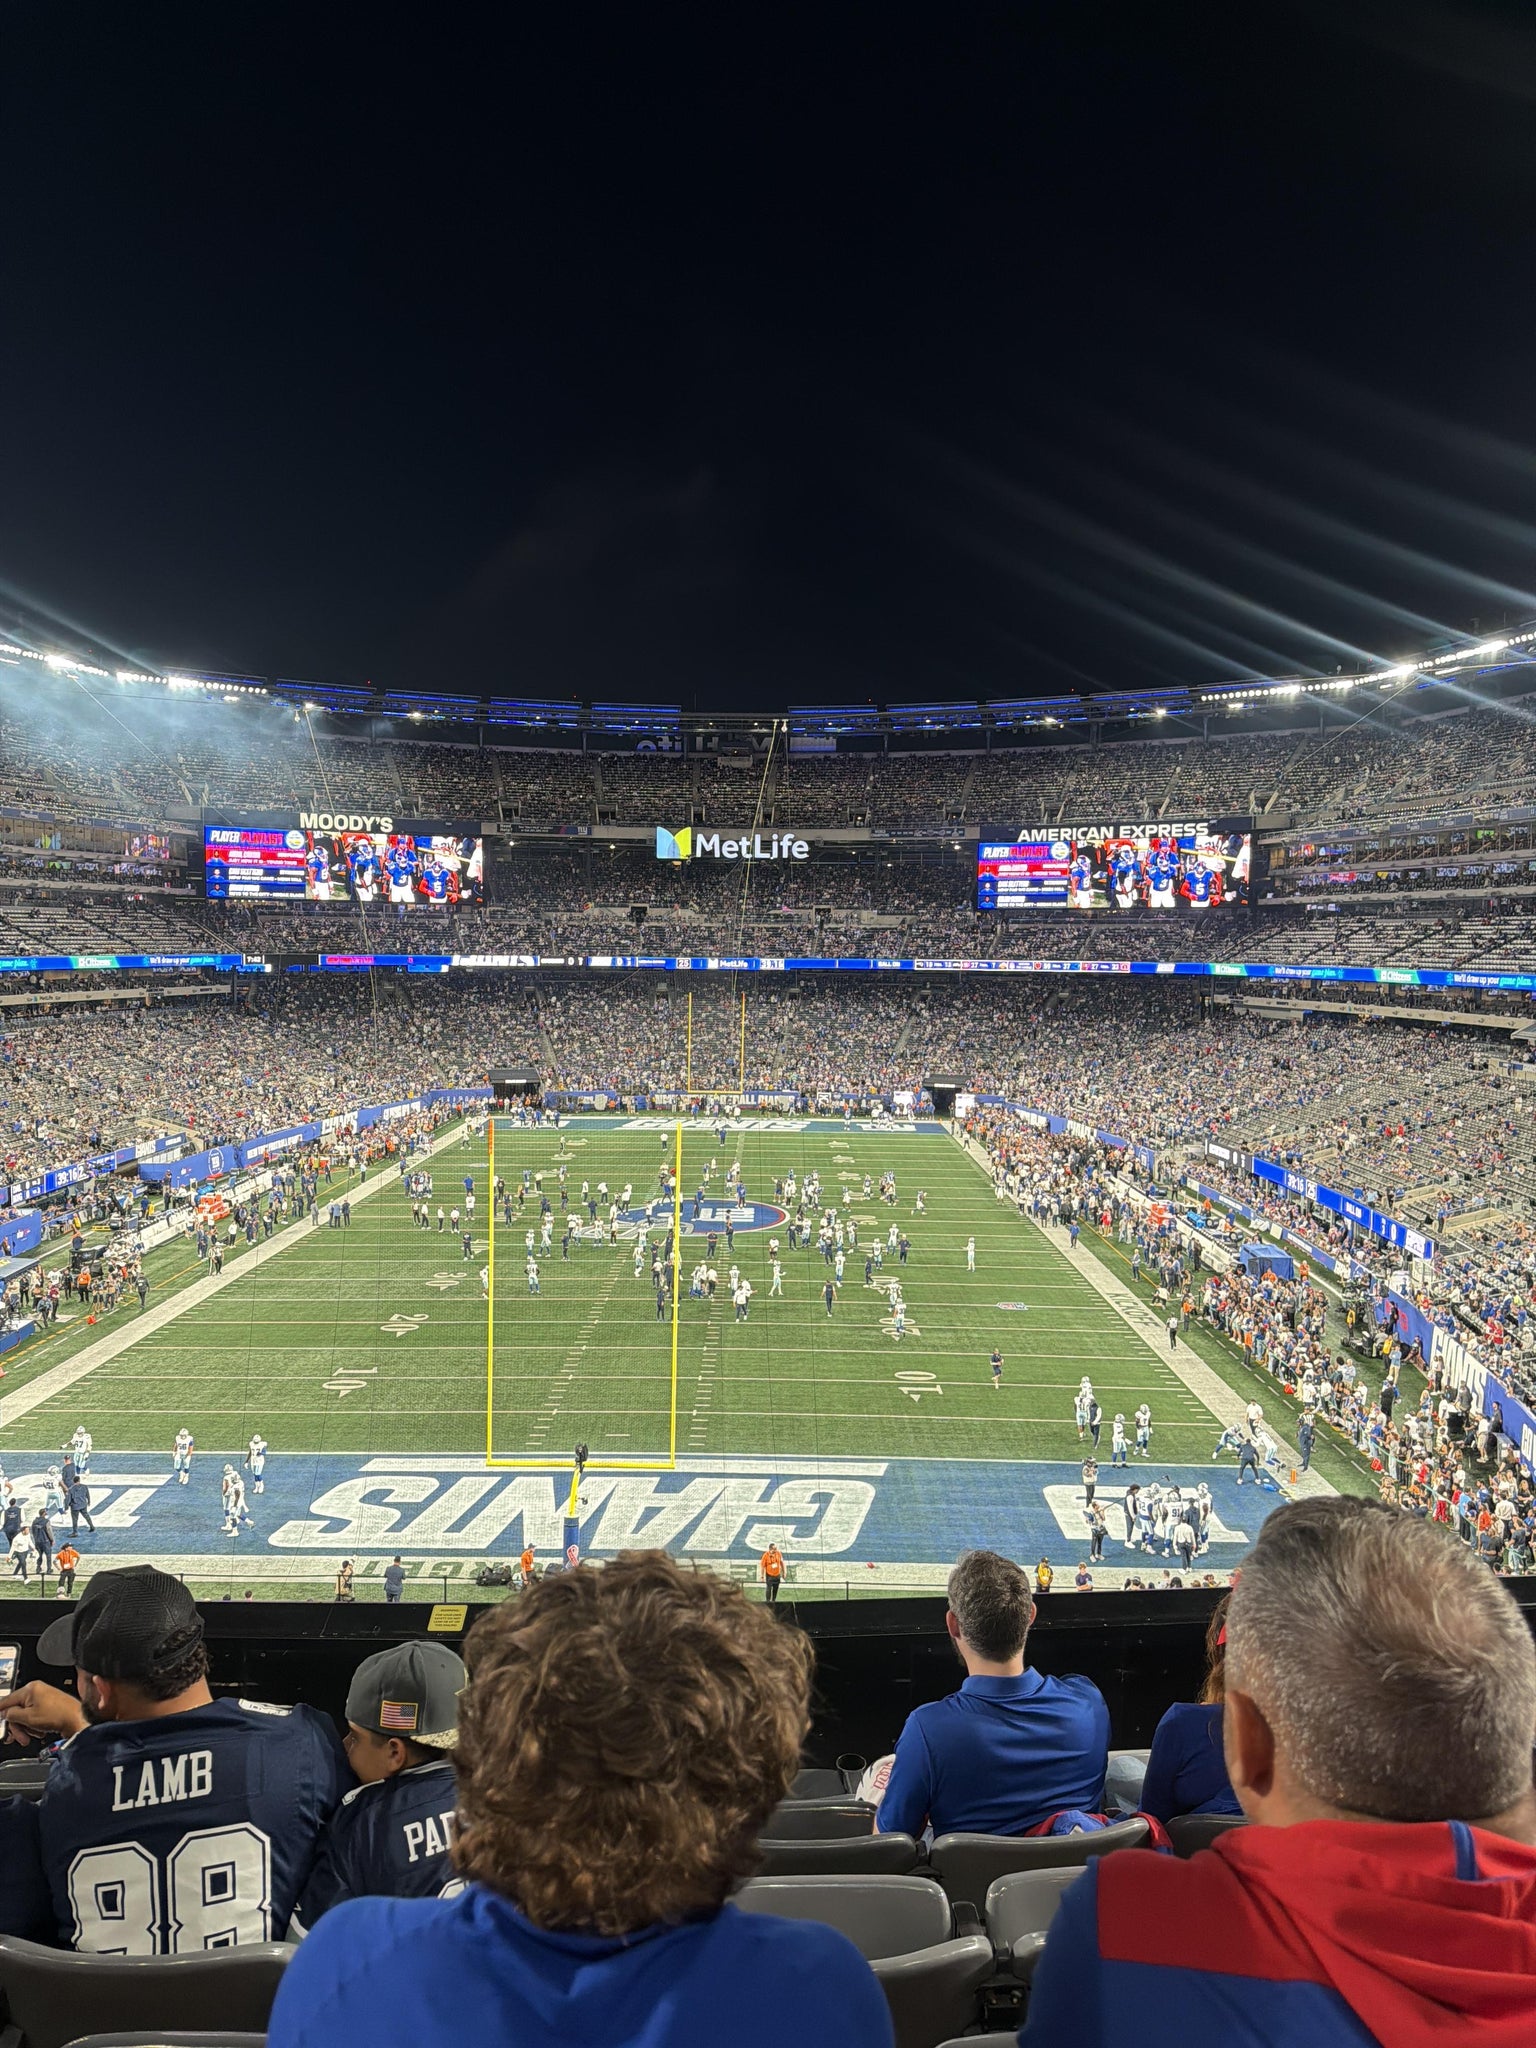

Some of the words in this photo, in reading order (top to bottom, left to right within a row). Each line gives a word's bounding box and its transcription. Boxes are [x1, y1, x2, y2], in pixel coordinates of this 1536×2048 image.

[300, 813, 393, 832] MOODY'S
[210, 830, 240, 843] PLAYER
[1017, 826, 1114, 843] AMERICAN
[1119, 823, 1209, 838] EXPRESS
[696, 833, 809, 859] MetLife
[983, 846, 1009, 858] PLAYER
[719, 959, 748, 968] MetLife
[1466, 975, 1479, 983] draw
[1487, 978, 1499, 987] your
[1500, 979, 1516, 988] game
[57, 1166, 78, 1186] 39:16
[1287, 1173, 1305, 1194] 39:16
[380, 1314, 429, 1332] 20
[322, 1366, 378, 1391] 10
[894, 1370, 944, 1395] 10
[267, 1475, 877, 1554] GIANTS
[112, 1750, 213, 1811] LAMB
